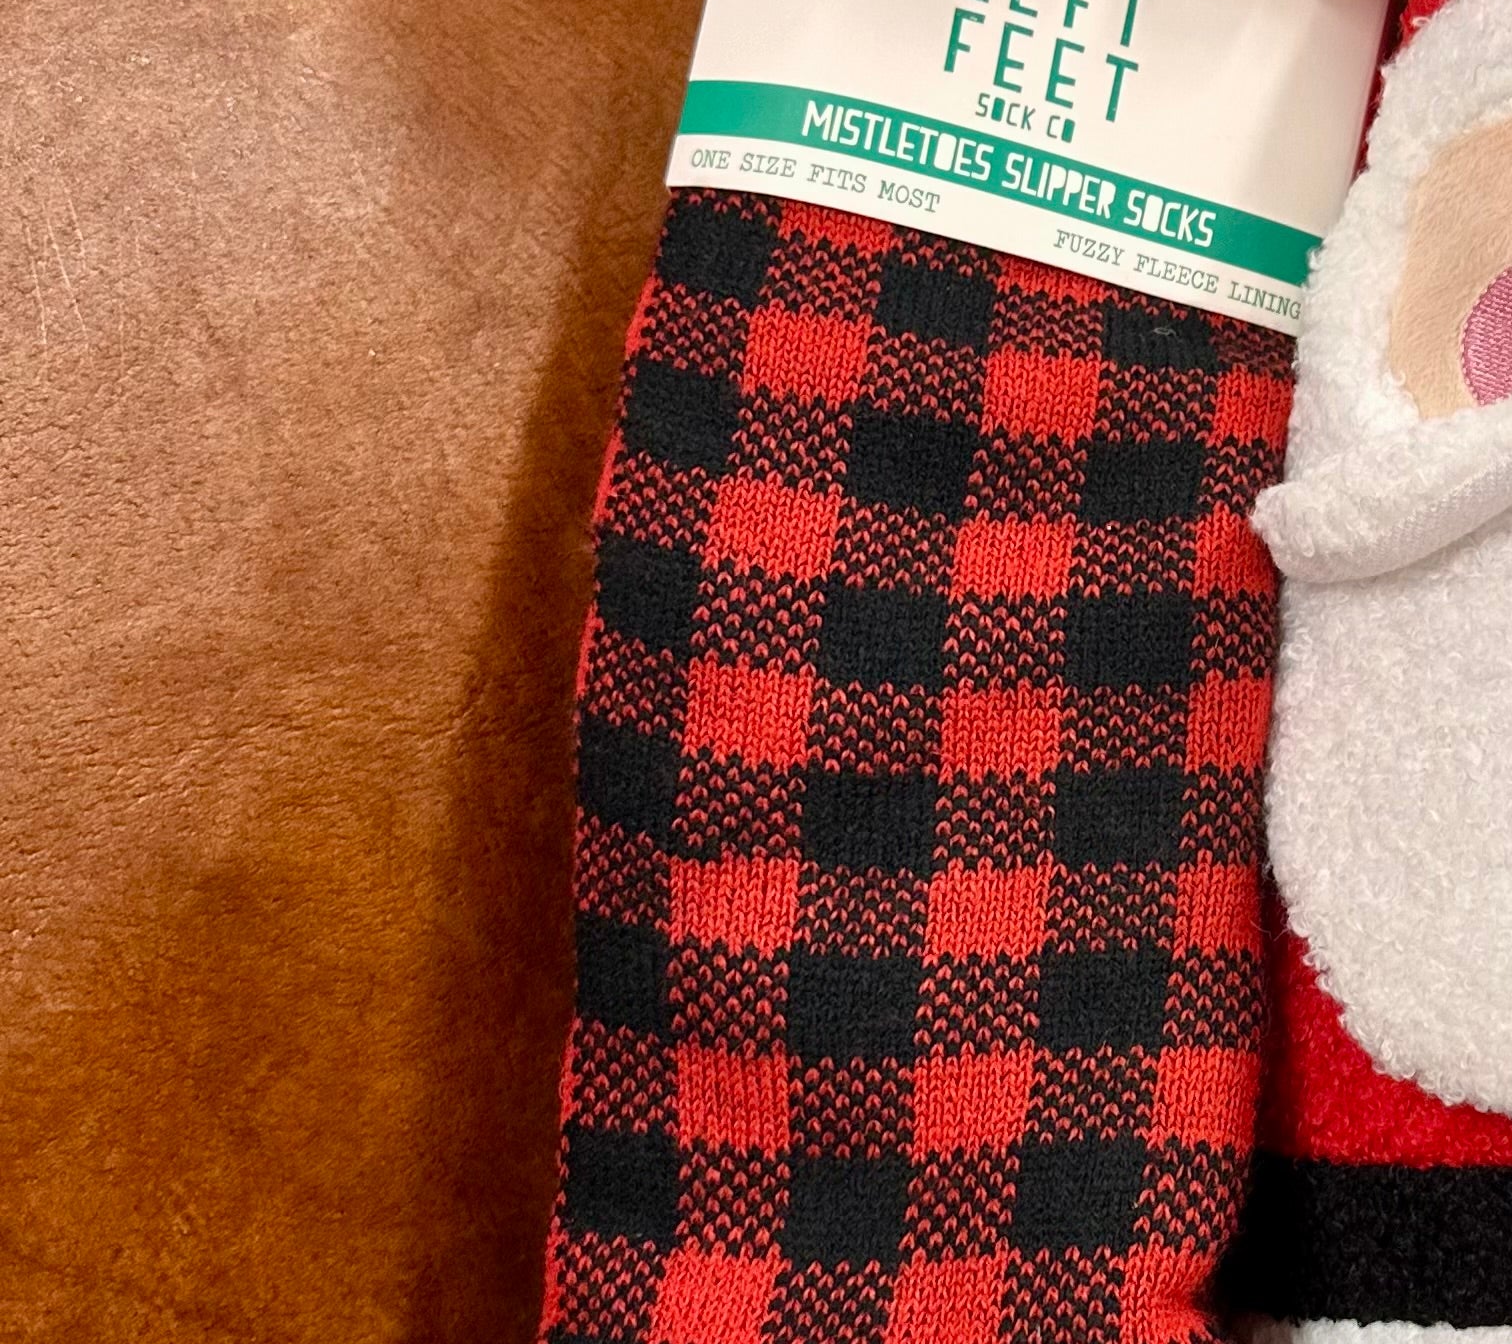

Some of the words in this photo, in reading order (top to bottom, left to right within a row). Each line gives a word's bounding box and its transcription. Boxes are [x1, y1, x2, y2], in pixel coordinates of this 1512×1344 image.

[944, 7, 1139, 123] FEET
[975, 92, 1036, 131] SOCK
[1046, 115, 1075, 143] CO
[690, 149, 732, 170] ONE
[739, 153, 797, 178] SIZE
[807, 163, 867, 193] FITS
[878, 180, 941, 213] MOST
[801, 100, 994, 181] MISTLETOES
[1001, 153, 1117, 219] SLIPPER
[1123, 189, 1217, 247] SOCKS
[1053, 229, 1125, 266] FUZZY
[1133, 253, 1219, 294] FLEECE
[1227, 281, 1301, 320] LINING
